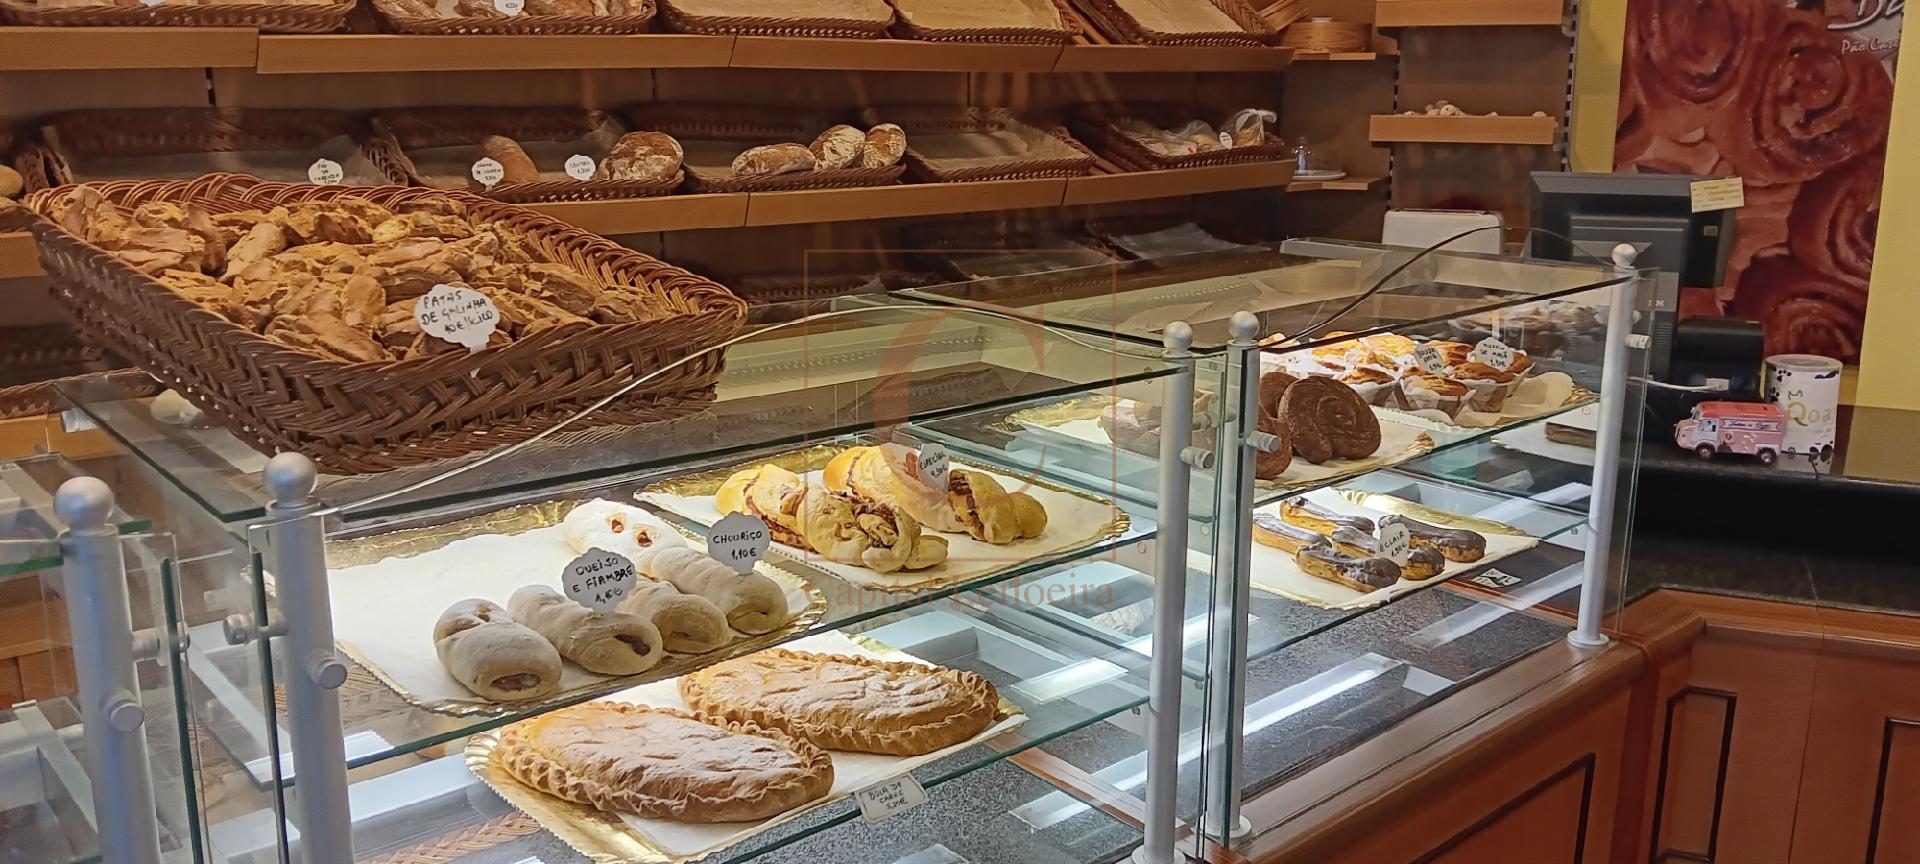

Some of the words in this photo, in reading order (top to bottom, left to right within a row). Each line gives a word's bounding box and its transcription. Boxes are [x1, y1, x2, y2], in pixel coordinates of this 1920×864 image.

[424, 290, 462, 309] PATAS
[421, 312, 438, 326] DE
[731, 548, 757, 560] 1,10€
[572, 584, 581, 593] E
